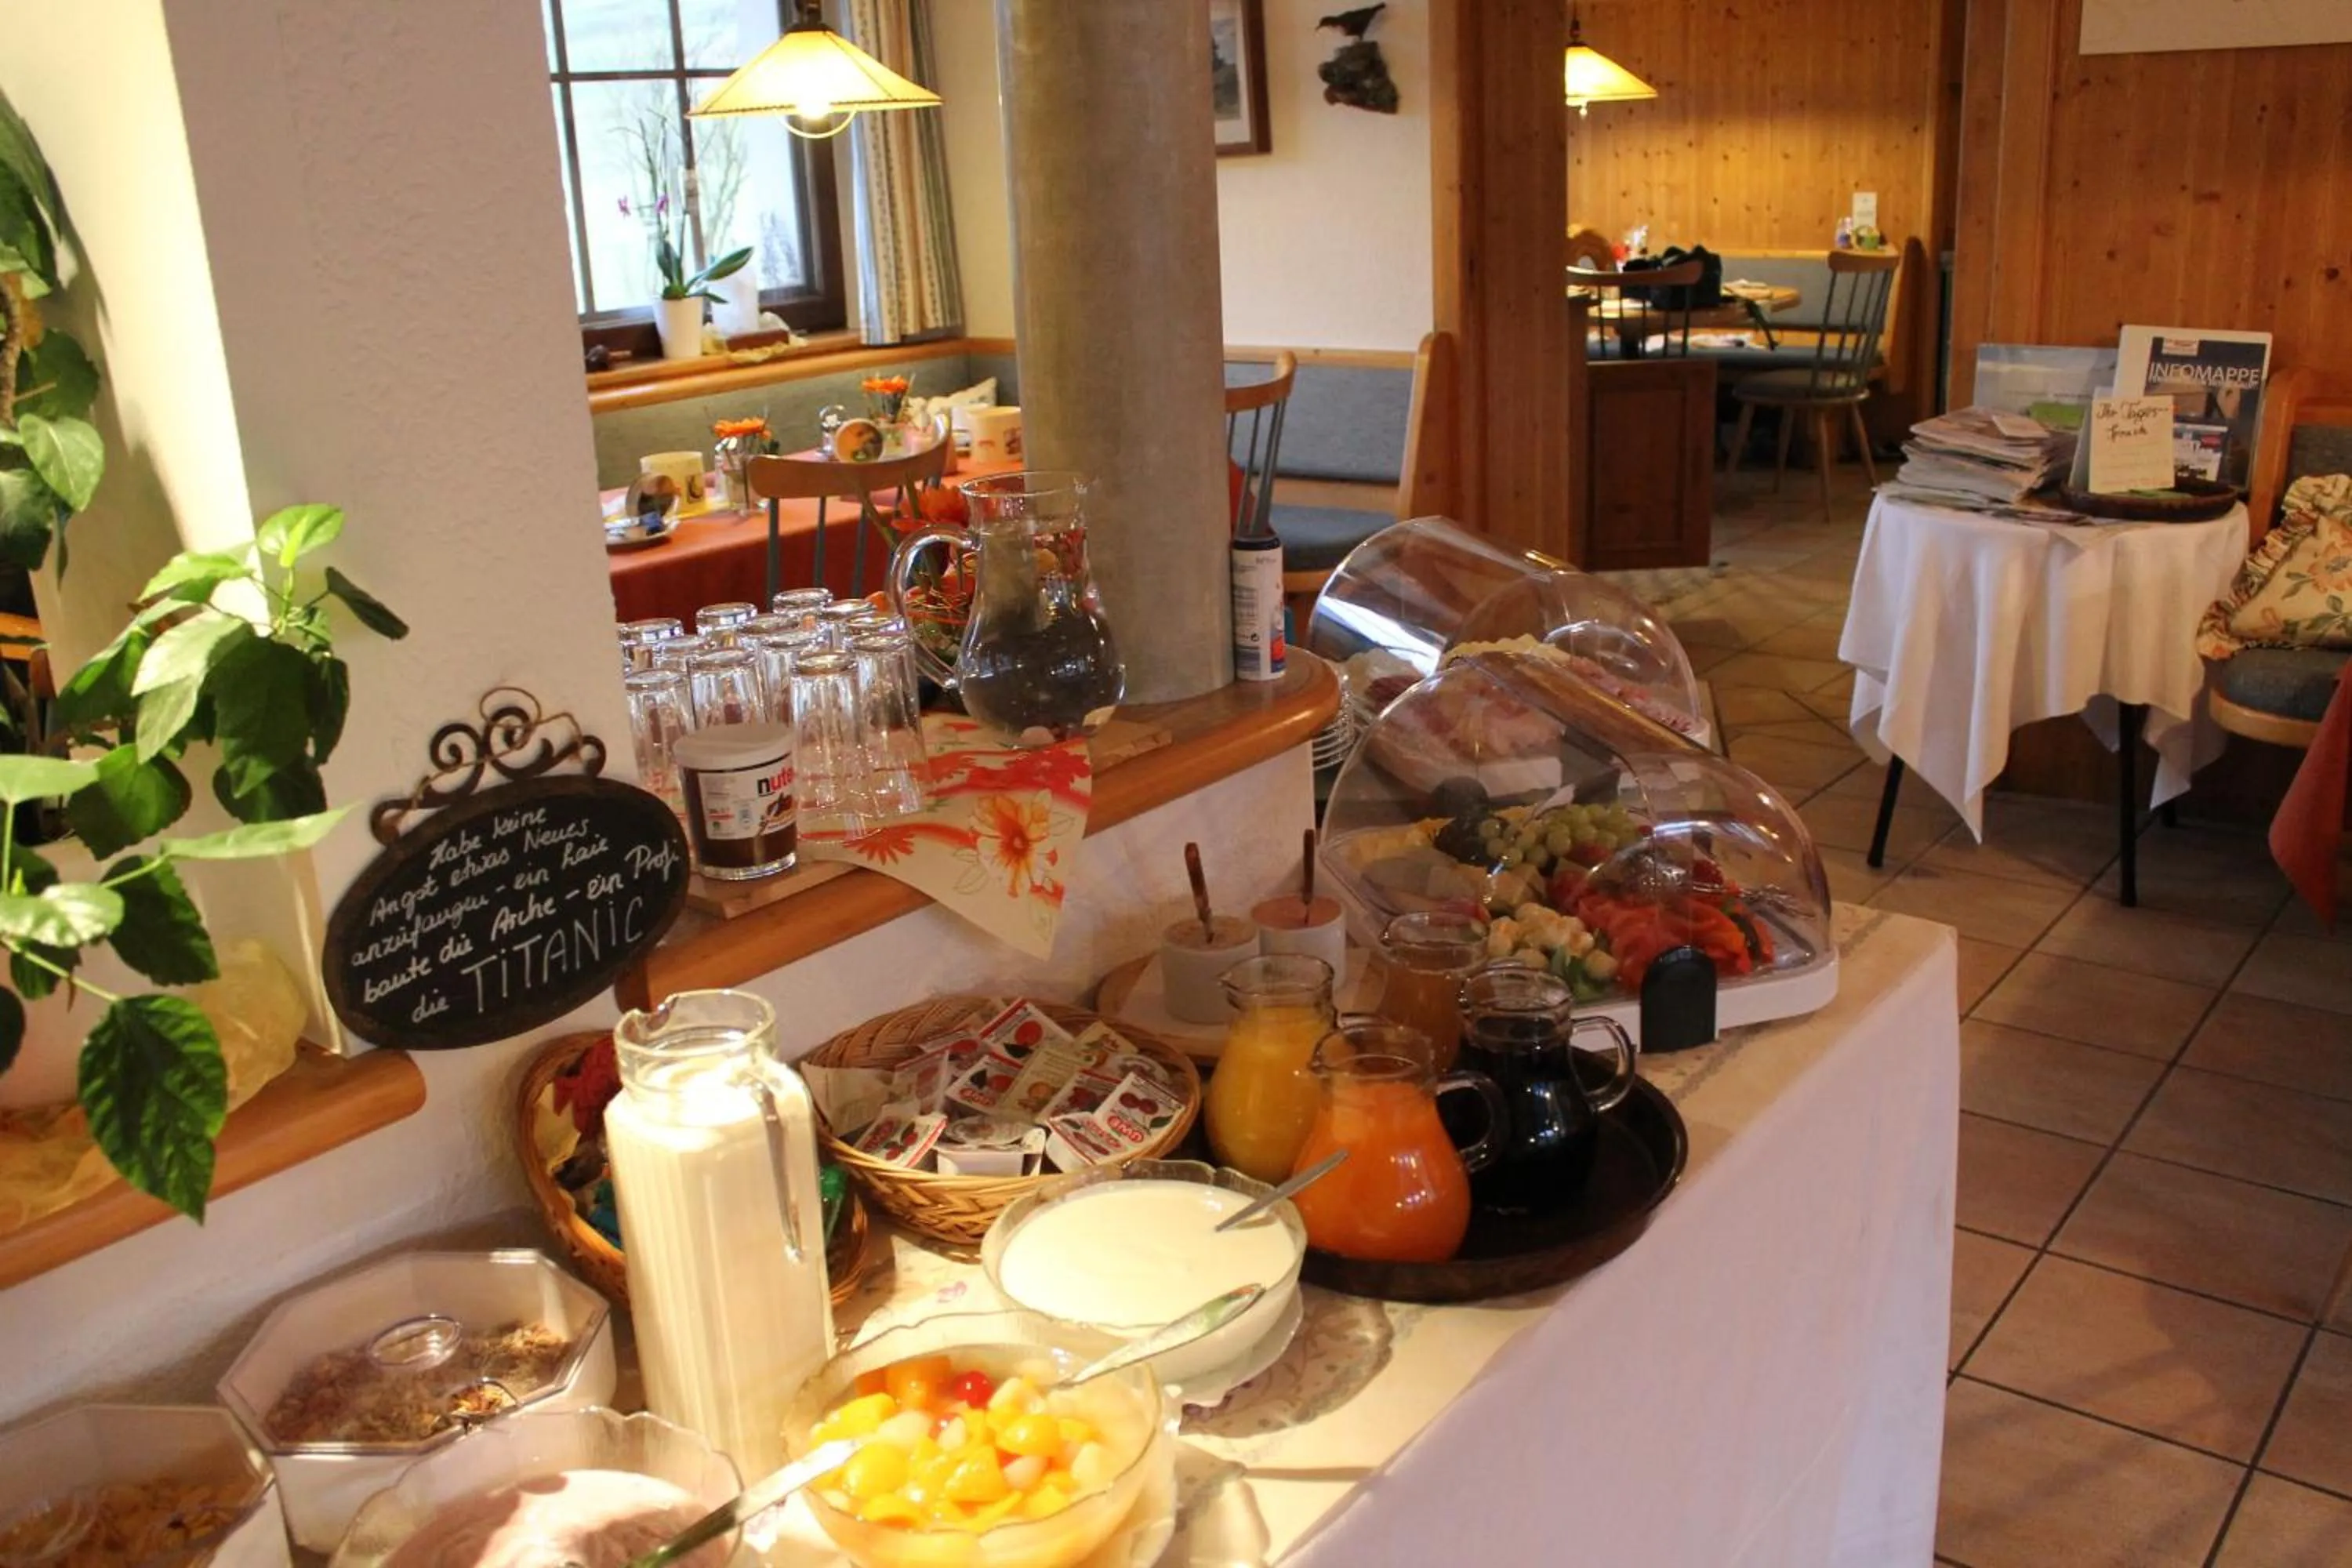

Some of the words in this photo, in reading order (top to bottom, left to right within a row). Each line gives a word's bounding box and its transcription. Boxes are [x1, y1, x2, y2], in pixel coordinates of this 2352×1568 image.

[2148, 361, 2260, 385] INFOMAPPE
[429, 829, 482, 869] Habe
[492, 808, 546, 839] keine
[369, 875, 439, 927] Angst
[450, 848, 510, 887] etwas
[524, 819, 590, 853] Neues
[514, 862, 549, 890] ein
[364, 955, 432, 1004] baute
[439, 934, 474, 964] die
[491, 893, 557, 942] Arche
[587, 873, 624, 899] ein
[624, 839, 681, 881] Profi
[411, 989, 451, 1024] die
